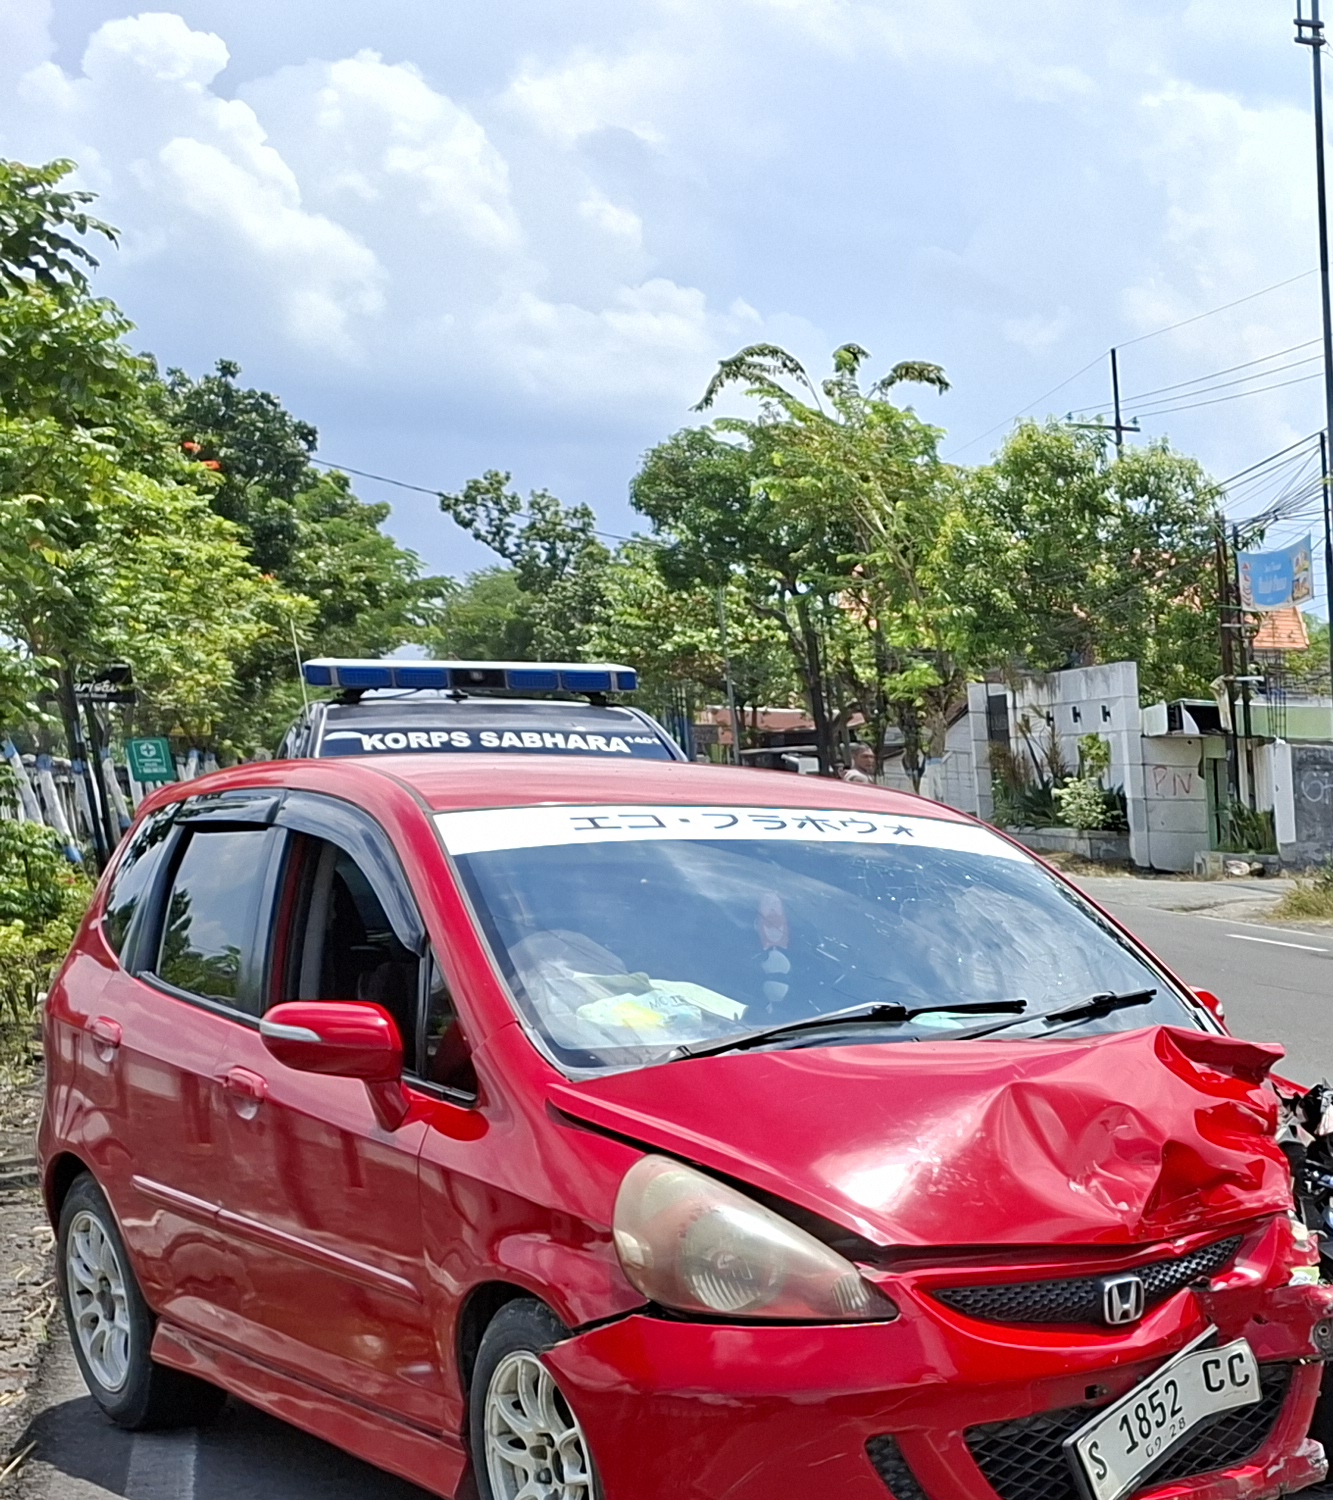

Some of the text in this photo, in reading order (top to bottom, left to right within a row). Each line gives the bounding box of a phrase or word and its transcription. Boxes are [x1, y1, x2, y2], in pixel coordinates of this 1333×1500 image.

[361, 731, 471, 751] KORPS
[480, 731, 632, 753] SABHARA
[1088, 1352, 1250, 1480] S 1852 CC
